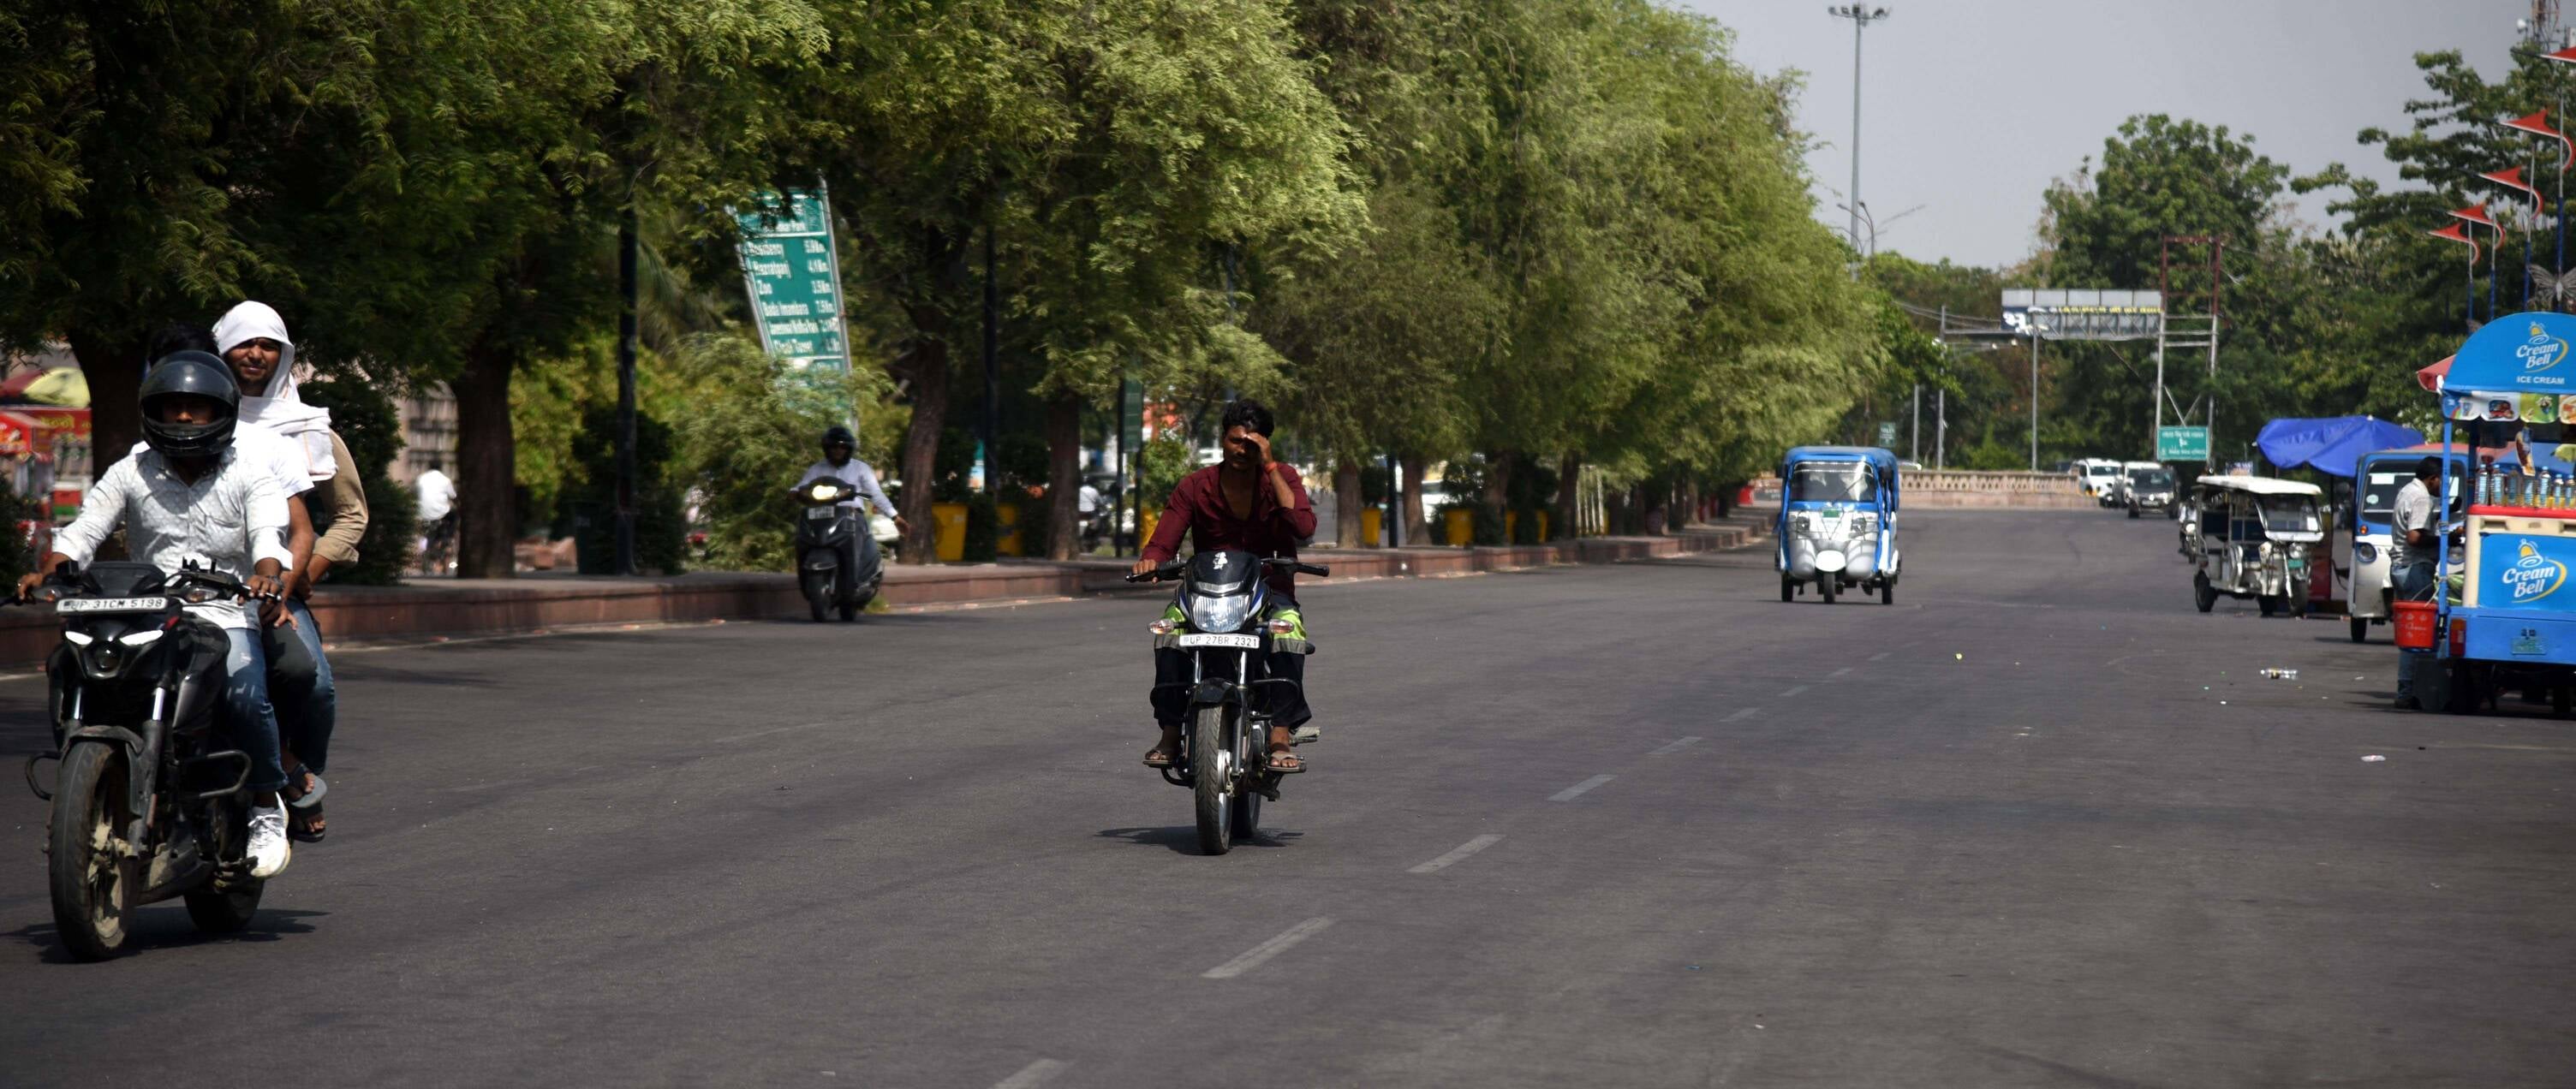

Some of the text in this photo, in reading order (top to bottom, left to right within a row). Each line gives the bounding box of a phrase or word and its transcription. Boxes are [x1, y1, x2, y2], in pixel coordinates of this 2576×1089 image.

[757, 279, 773, 295] Zoo
[2516, 342, 2559, 358] Cream
[2525, 353, 2551, 369] Bell
[2533, 376, 2566, 384] CREAM
[2502, 566, 2555, 584] Cream
[2513, 578, 2546, 598] Bell
[130, 598, 163, 608] 5198
[1190, 635, 1256, 647] UP 27BR 2321
